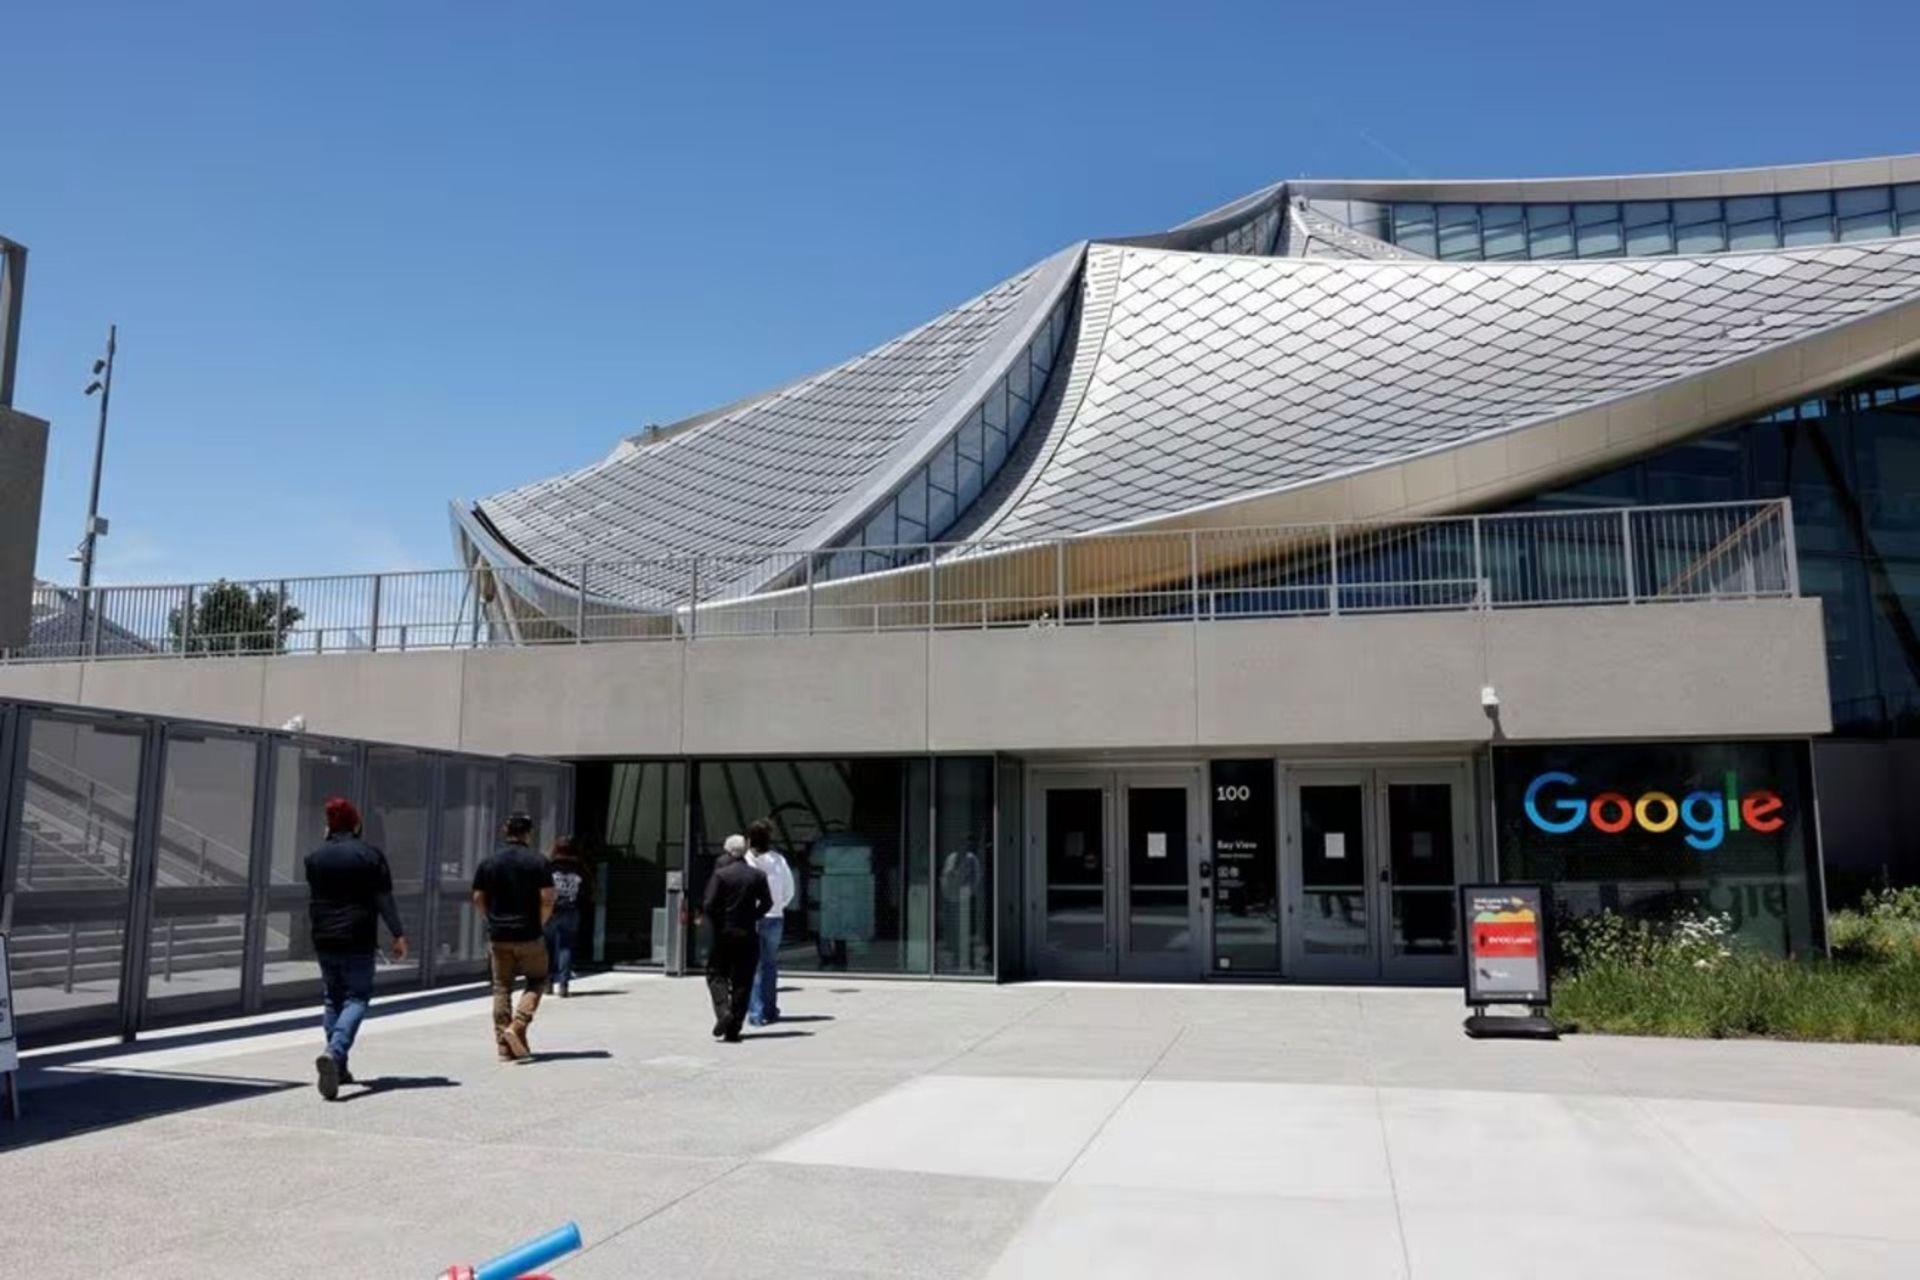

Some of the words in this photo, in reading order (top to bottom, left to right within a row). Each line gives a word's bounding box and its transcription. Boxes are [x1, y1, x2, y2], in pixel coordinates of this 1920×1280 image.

[1217, 785, 1250, 801] 100
[1524, 771, 1785, 851] Google
[1217, 840, 1233, 850] Bay
[1235, 839, 1257, 850] View
